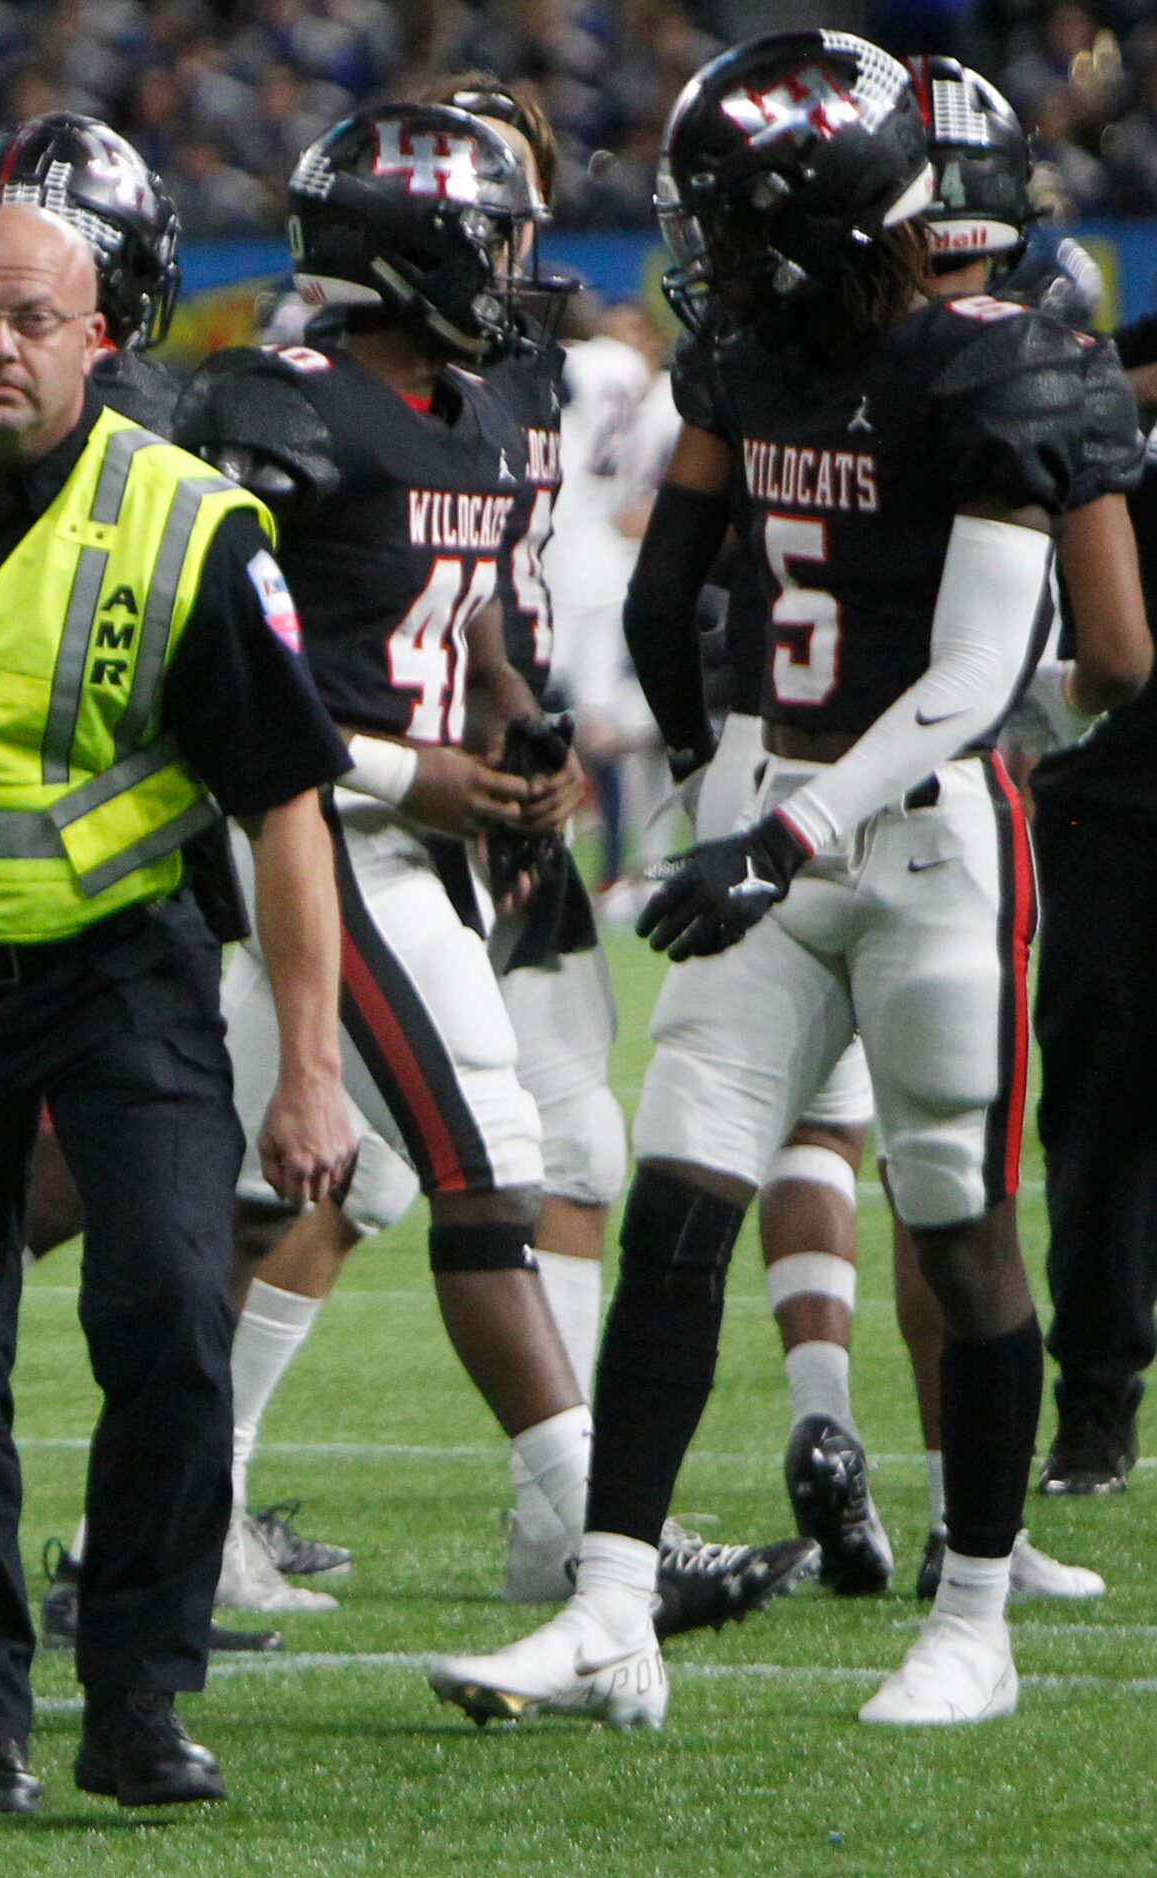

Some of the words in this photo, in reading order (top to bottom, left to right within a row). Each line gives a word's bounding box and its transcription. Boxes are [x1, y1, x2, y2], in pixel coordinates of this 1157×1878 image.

[743, 437, 879, 513] WILDCATS
[90, 584, 138, 686] AMR
[763, 511, 841, 706] 5
